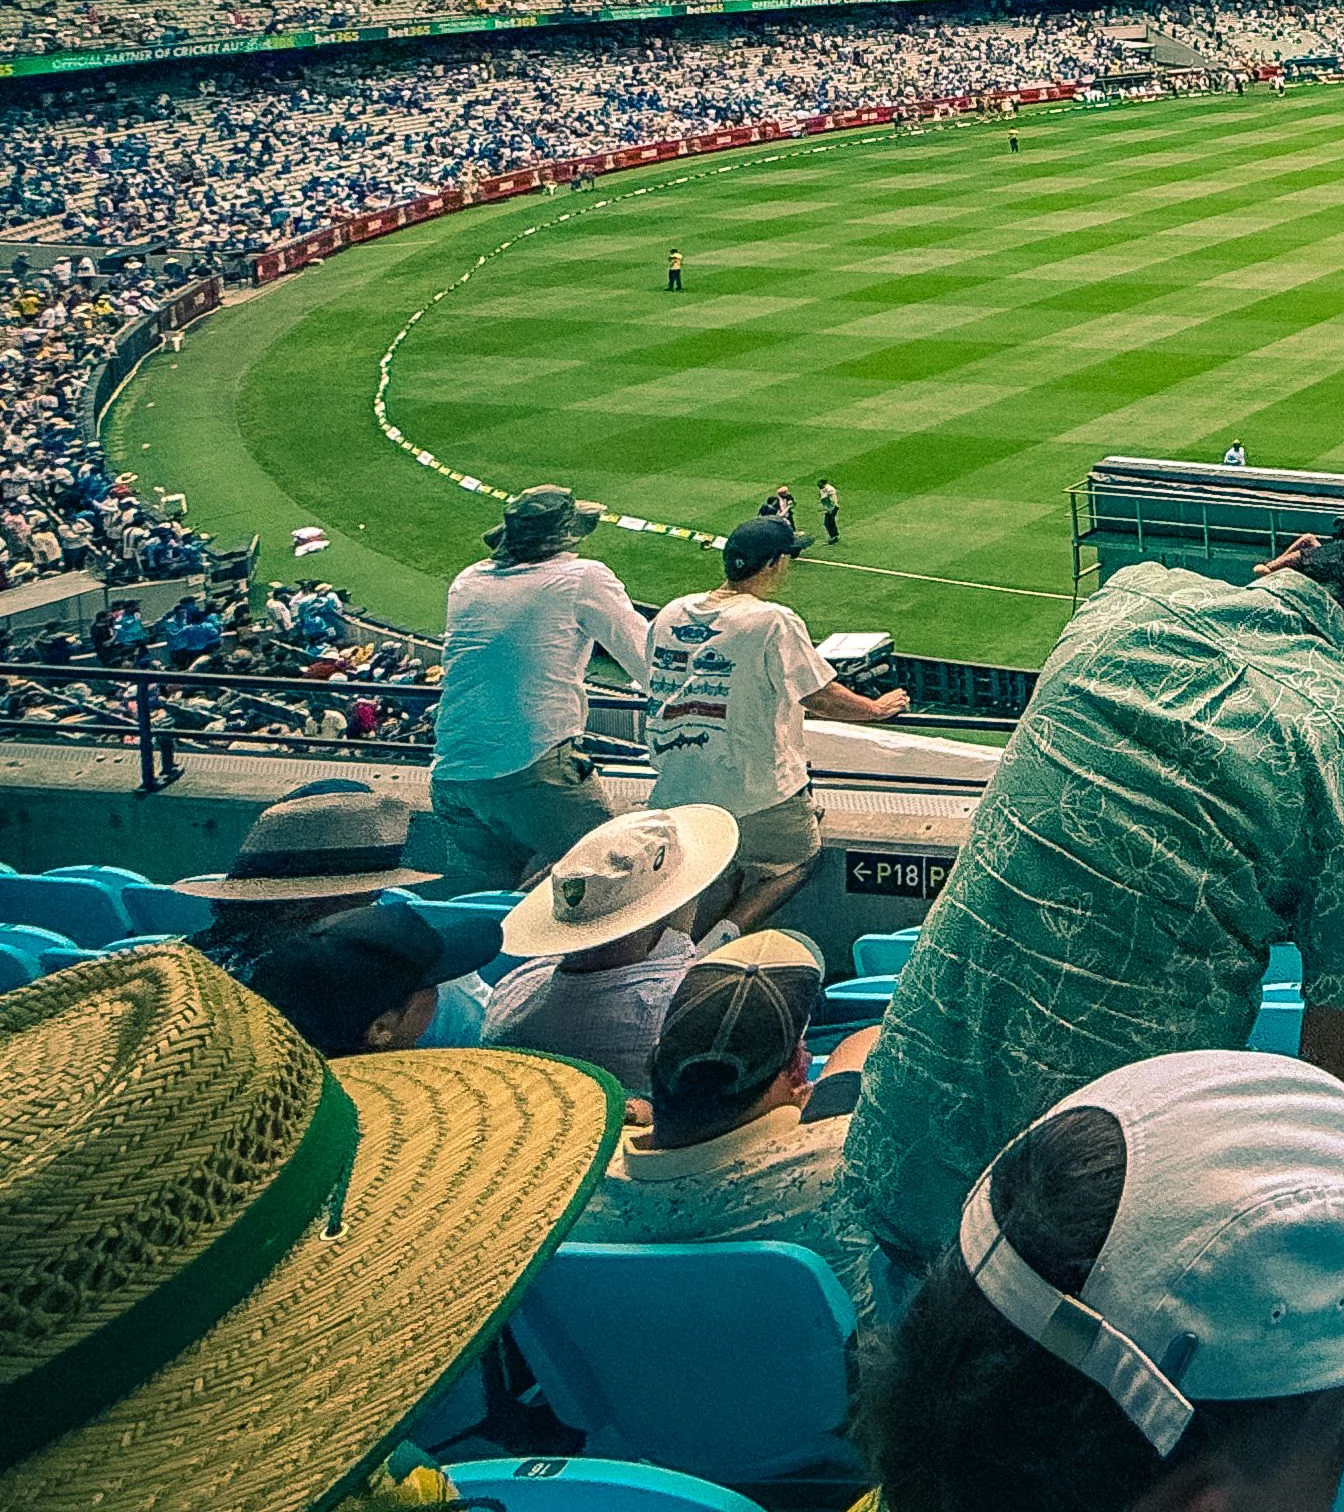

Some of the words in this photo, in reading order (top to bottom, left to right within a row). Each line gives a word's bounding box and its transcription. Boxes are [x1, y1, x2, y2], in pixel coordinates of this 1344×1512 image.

[315, 31, 360, 45] bet365
[103, 50, 153, 64] PARTNER
[154, 48, 171, 59] OF
[173, 42, 219, 57] CRICKET
[877, 862, 919, 886] P18
